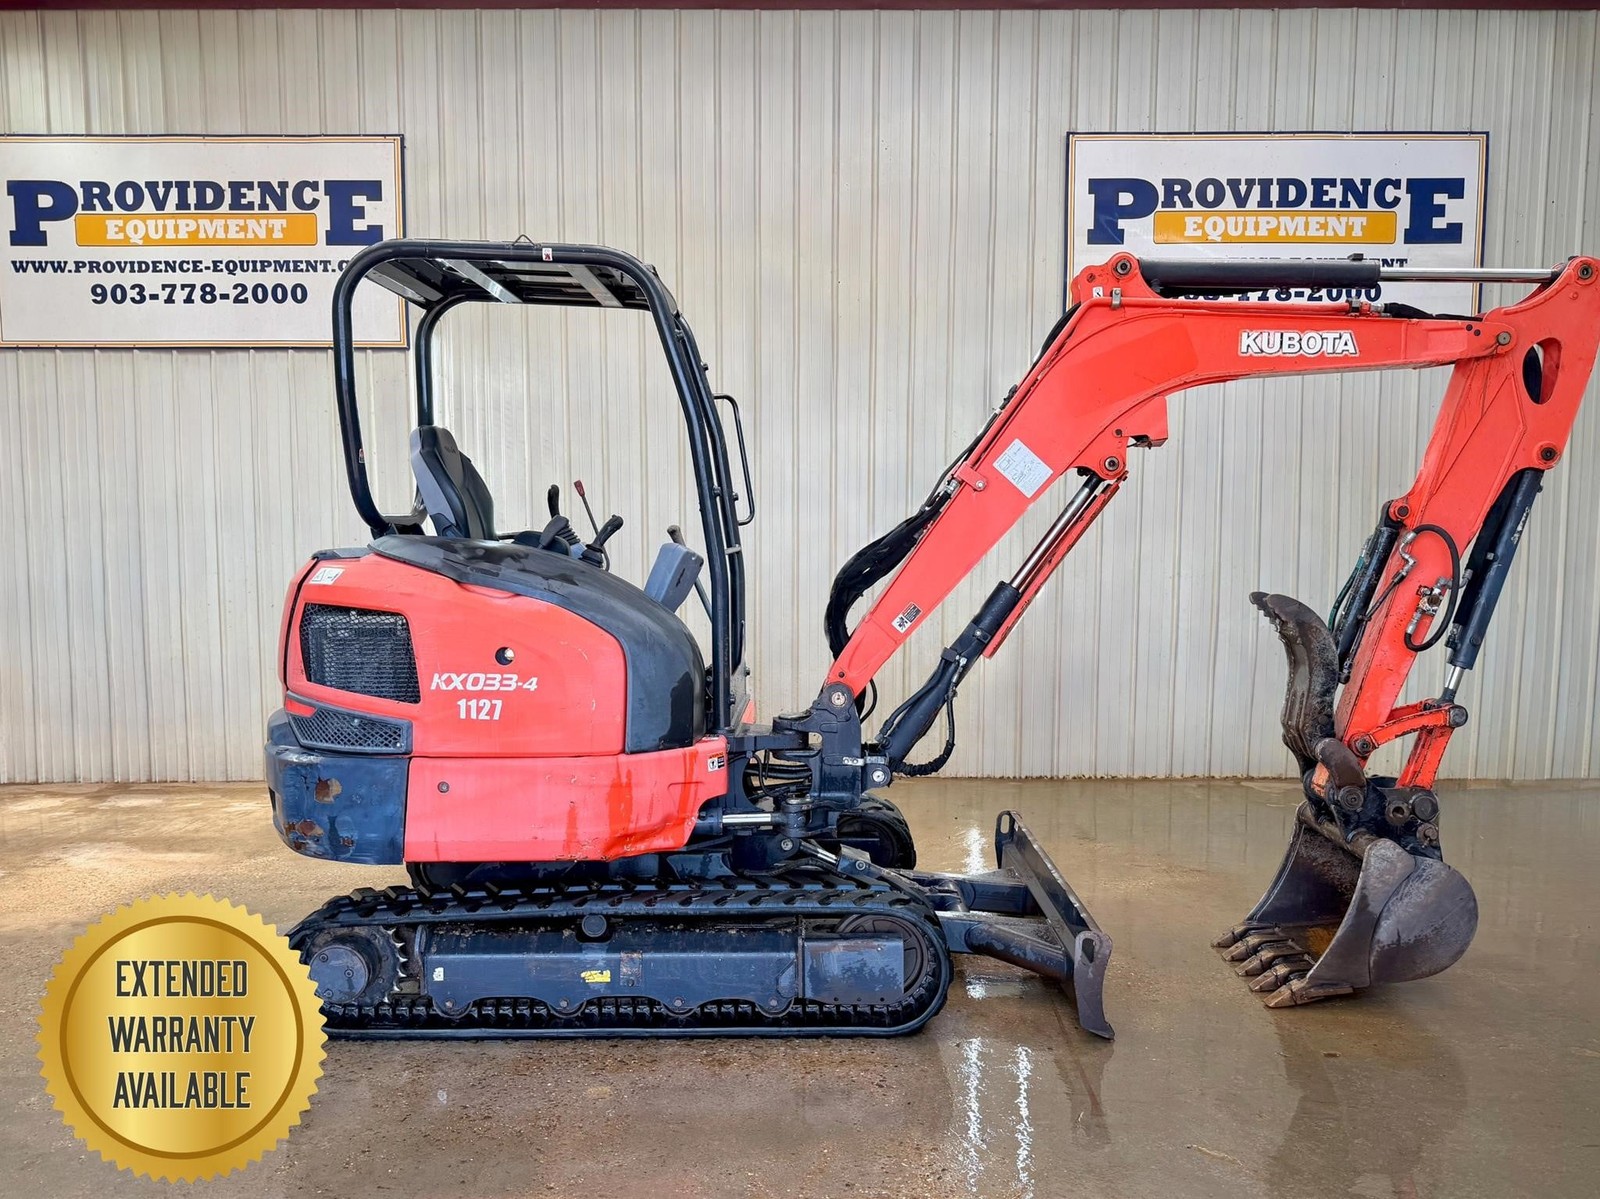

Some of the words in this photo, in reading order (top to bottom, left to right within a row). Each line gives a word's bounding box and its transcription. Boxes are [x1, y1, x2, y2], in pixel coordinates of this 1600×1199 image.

[7, 180, 383, 246] PROVIDENCE
[1087, 177, 1465, 245] PROVIDENCE
[106, 219, 287, 245] EQUIPMENT
[1184, 216, 1367, 241] EQUIPMENT
[90, 282, 308, 305] 903-778-2000
[1240, 330, 1358, 356] KUBOTA
[430, 673, 538, 691] KX033-4
[457, 698, 502, 720] 1127
